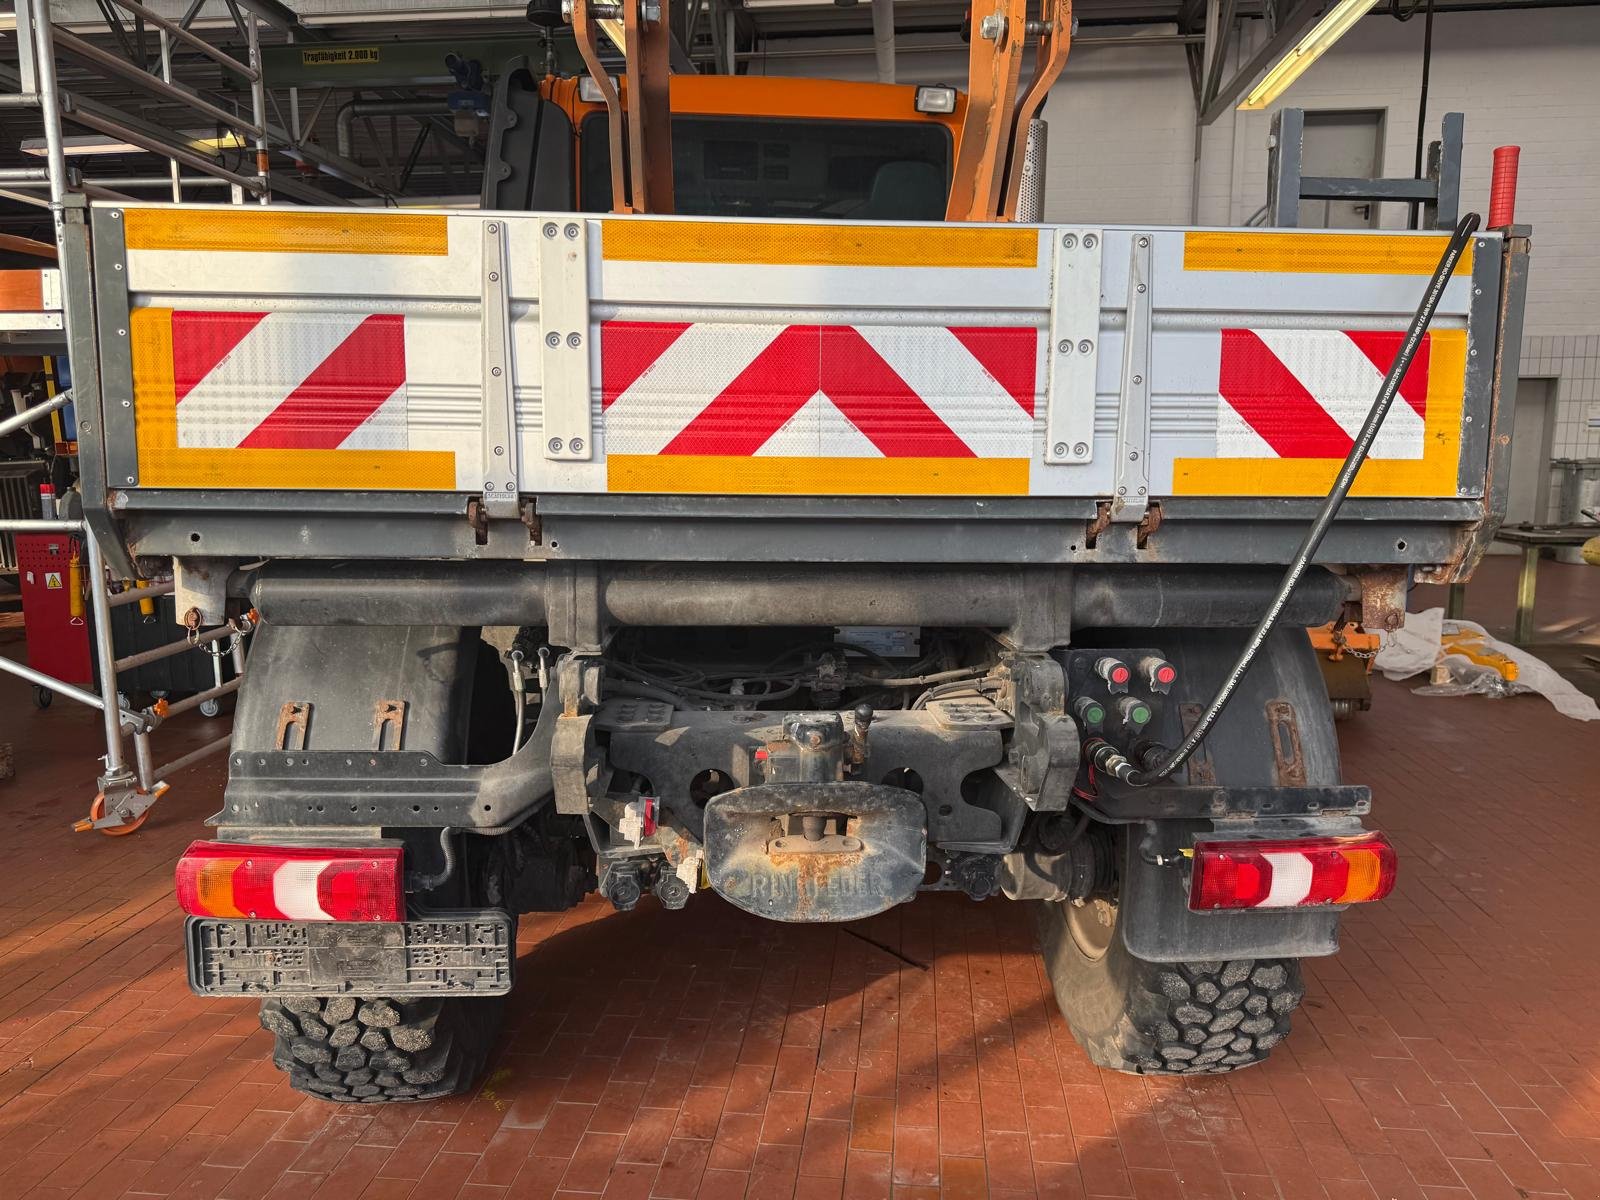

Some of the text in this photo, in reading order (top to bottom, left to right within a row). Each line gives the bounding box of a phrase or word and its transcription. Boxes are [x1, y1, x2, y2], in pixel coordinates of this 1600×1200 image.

[303, 48, 378, 63] Tragfähigkeit 2.000 kg
[1445, 249, 1458, 268] PARKER
[1433, 265, 1449, 290] NO-SKIVE
[1293, 556, 1307, 579] PARKER
[752, 871, 884, 898] RINEDER
